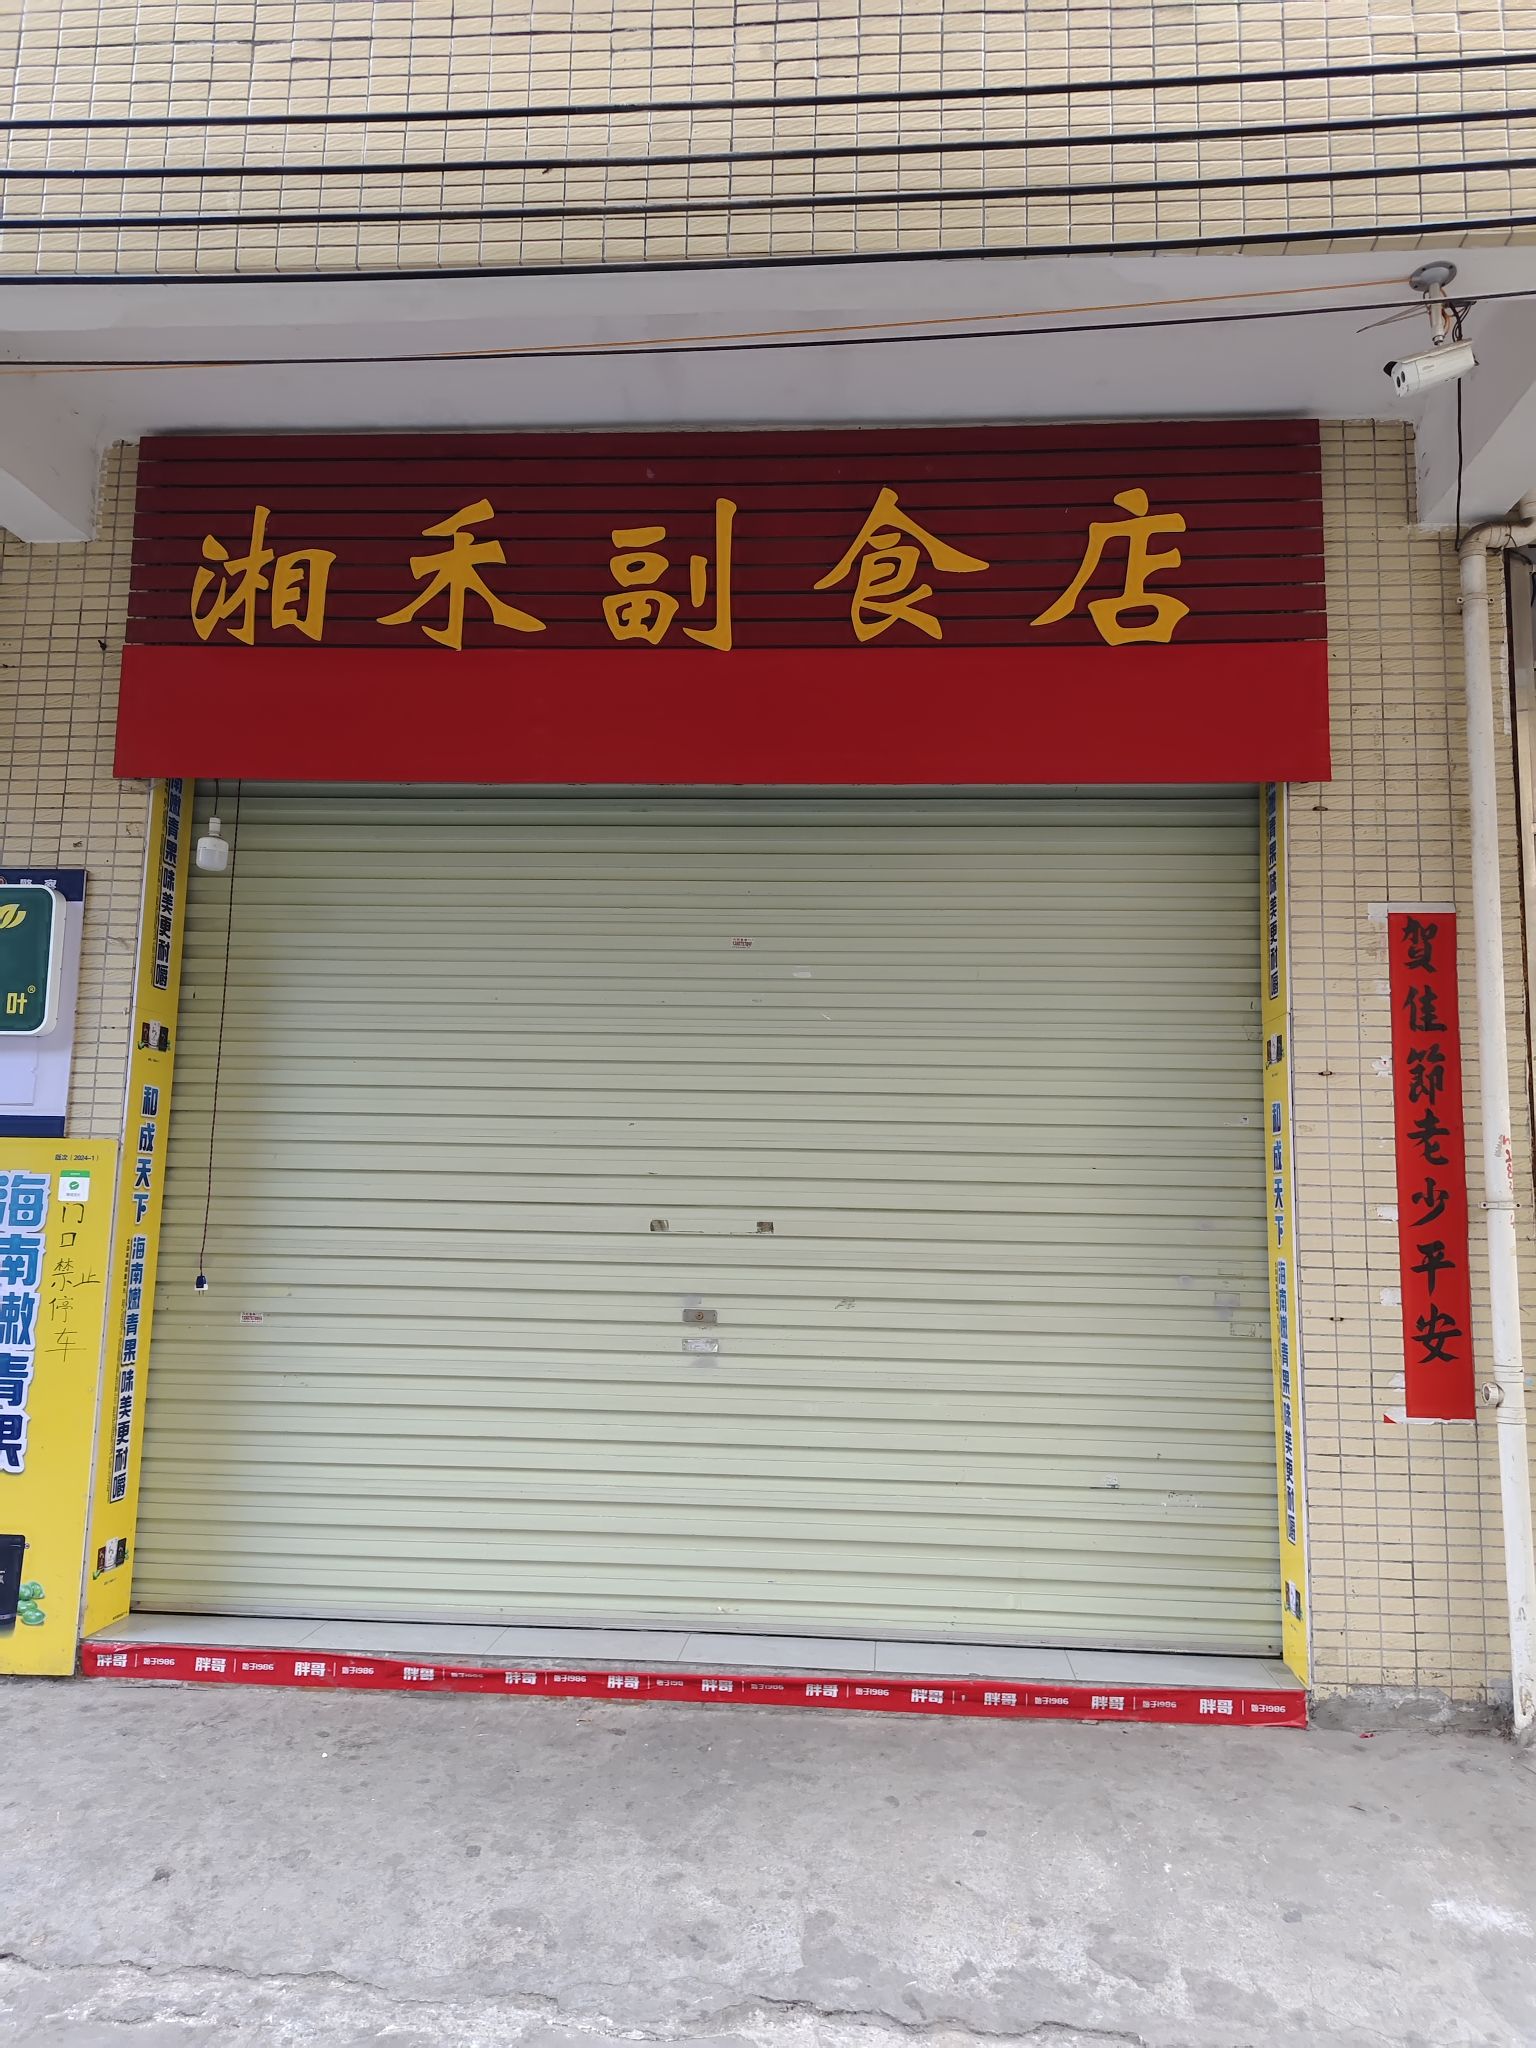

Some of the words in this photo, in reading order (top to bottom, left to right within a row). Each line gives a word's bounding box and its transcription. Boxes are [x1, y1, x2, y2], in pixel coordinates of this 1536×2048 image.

[190, 488, 1190, 651] 湘禾副食店
[133, 1085, 159, 1223] 和成天下
[97, 1653, 128, 1668] 胖哥
[195, 1657, 226, 1672] 胖哥
[295, 1661, 326, 1676] 胖哥
[505, 1672, 537, 1685] 胖哥
[607, 1675, 640, 1690] 胖哥
[701, 1679, 733, 1692] 胖哥
[806, 1683, 839, 1698] 胖哥
[911, 1688, 944, 1703] 胖哥
